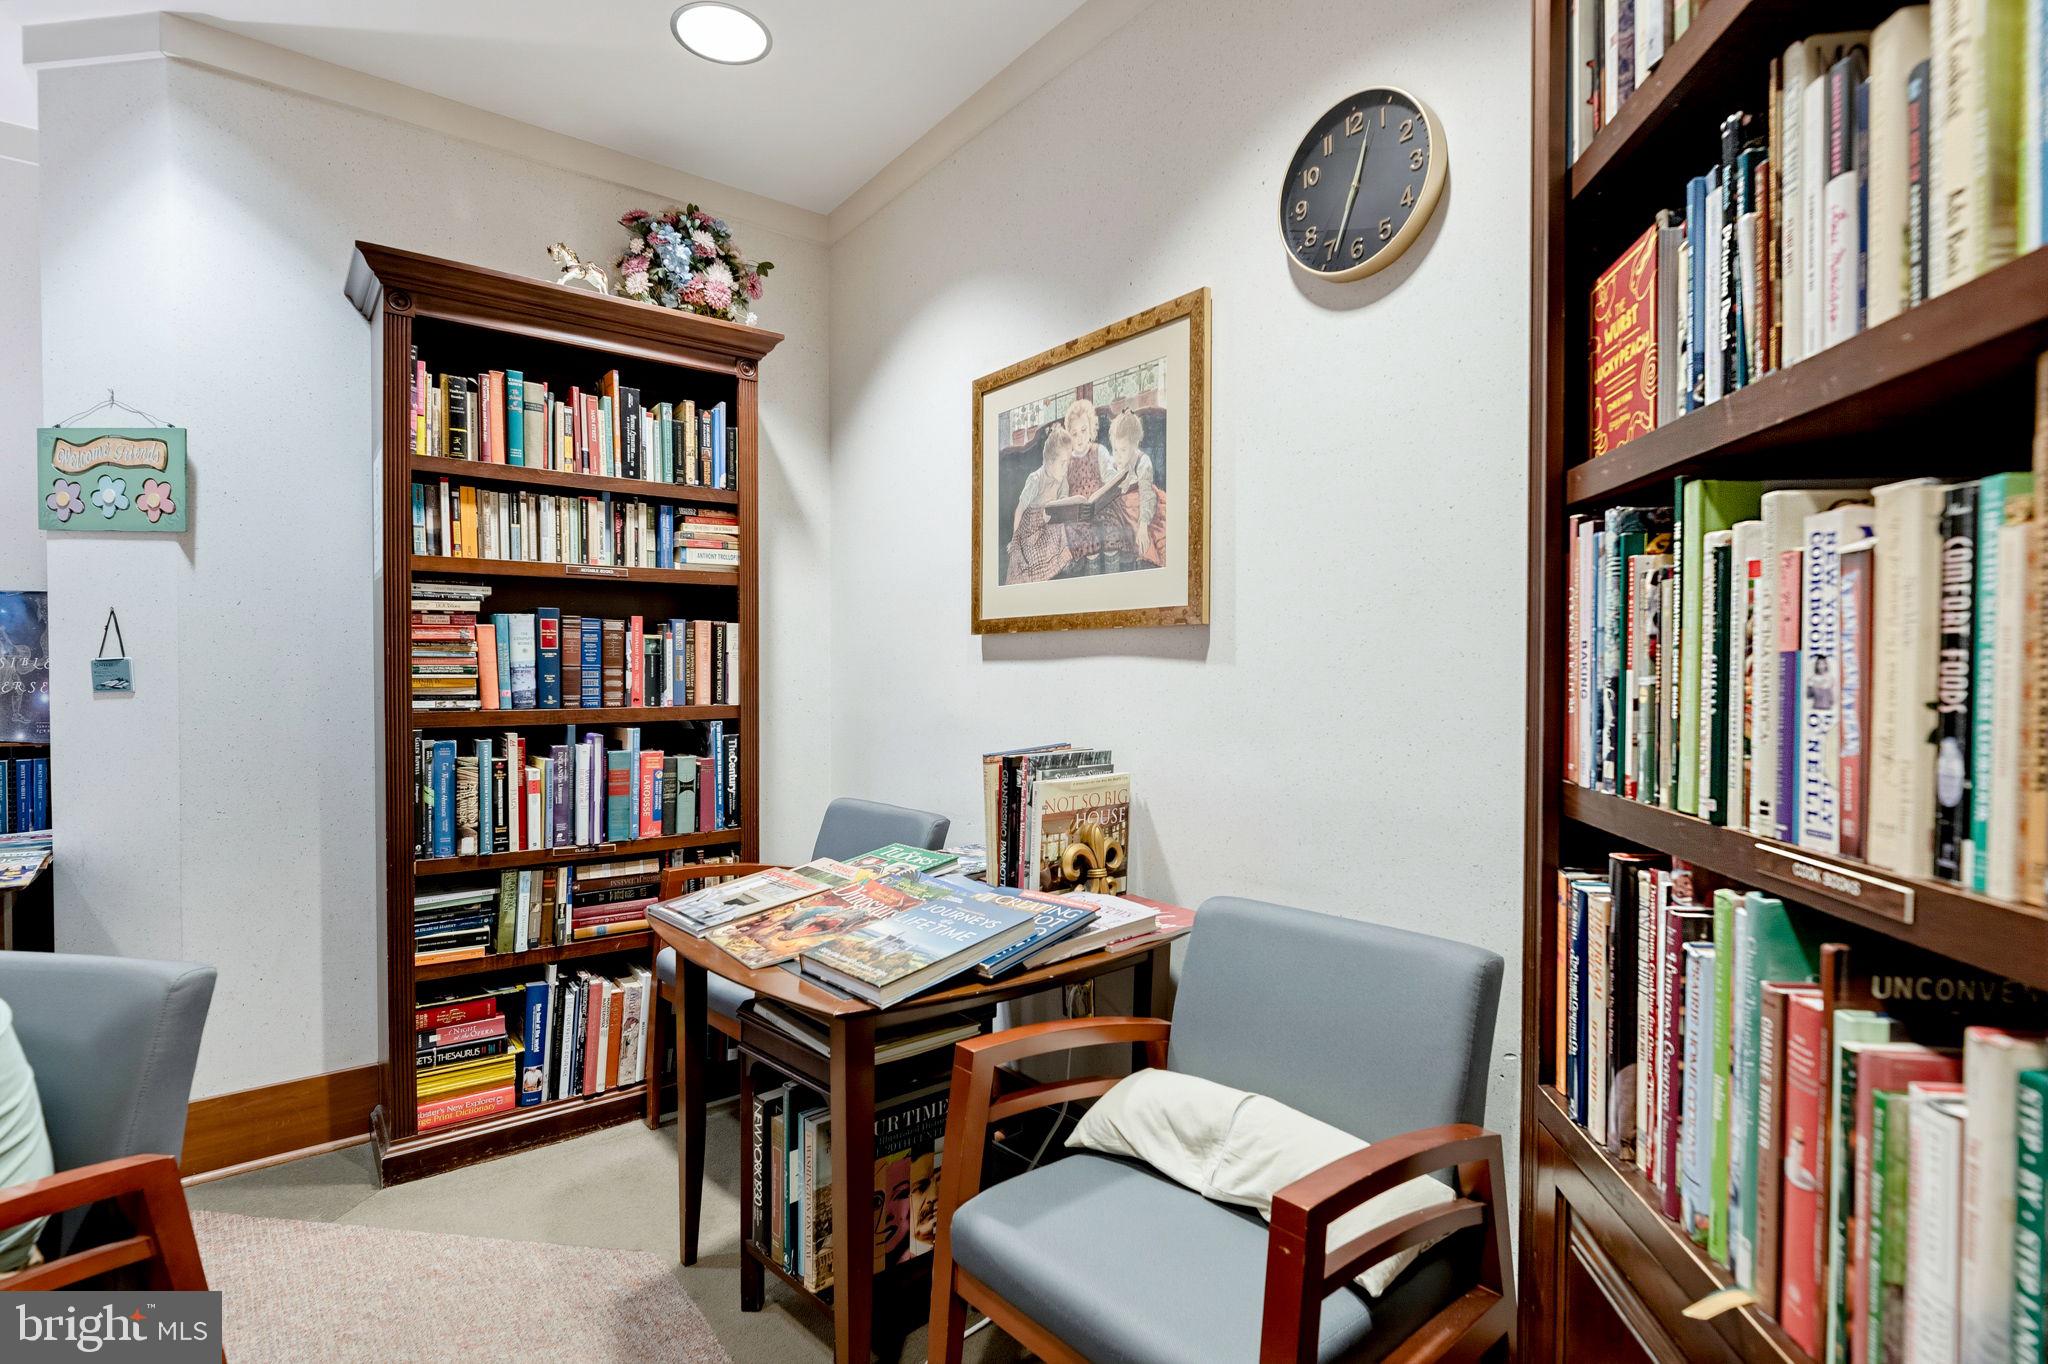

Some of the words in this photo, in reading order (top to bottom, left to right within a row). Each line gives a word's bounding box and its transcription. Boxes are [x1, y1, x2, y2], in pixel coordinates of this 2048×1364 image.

[1345, 111, 1364, 137] 12
[1380, 107, 1385, 128] 1
[1400, 119, 1414, 143] 2
[1323, 134, 1334, 157] 11
[1409, 148, 1424, 171] 3
[1303, 166, 1320, 189] 10
[1400, 184, 1414, 208] 4
[1295, 200, 1308, 221] 9
[1304, 226, 1317, 247] 8
[1378, 216, 1392, 240] 5
[1324, 238, 1336, 261] 7
[1351, 237, 1364, 260] 6
[1604, 303, 1638, 346] WURST
[113, 444, 161, 464] Friends
[1825, 532, 1837, 588] NEW
[1809, 531, 1824, 660] COOKBOOK
[1941, 537, 1973, 637] COMFORT
[1672, 574, 1680, 646] INTERNATIONAL
[1825, 600, 1836, 660] YORK
[1937, 649, 1969, 714] FOODS
[727, 756, 738, 794] Century
[643, 775, 651, 816] LAROUSSE
[1000, 769, 1009, 837] GRANDISSIMO
[1044, 796, 1078, 814] NOT
[1082, 792, 1101, 807] SO
[1104, 788, 1128, 804] BIG
[1075, 807, 1126, 830] HOUSE
[921, 902, 1002, 929] JOURNEYS
[994, 896, 1084, 919] CREATING
[895, 912, 977, 943] LIFETIME
[454, 1026, 476, 1035] NIGHT
[470, 1030, 494, 1039] OPERA
[438, 1048, 481, 1062] THESAURUS
[1761, 1016, 1774, 1080] CHARLIE
[433, 1113, 453, 1124] Print
[456, 1104, 496, 1117] Dictionary
[447, 1104, 463, 1114] New
[465, 1097, 495, 1111] Explorer
[1760, 1084, 1773, 1148] TROTTER
[753, 1101, 763, 1142] NEW
